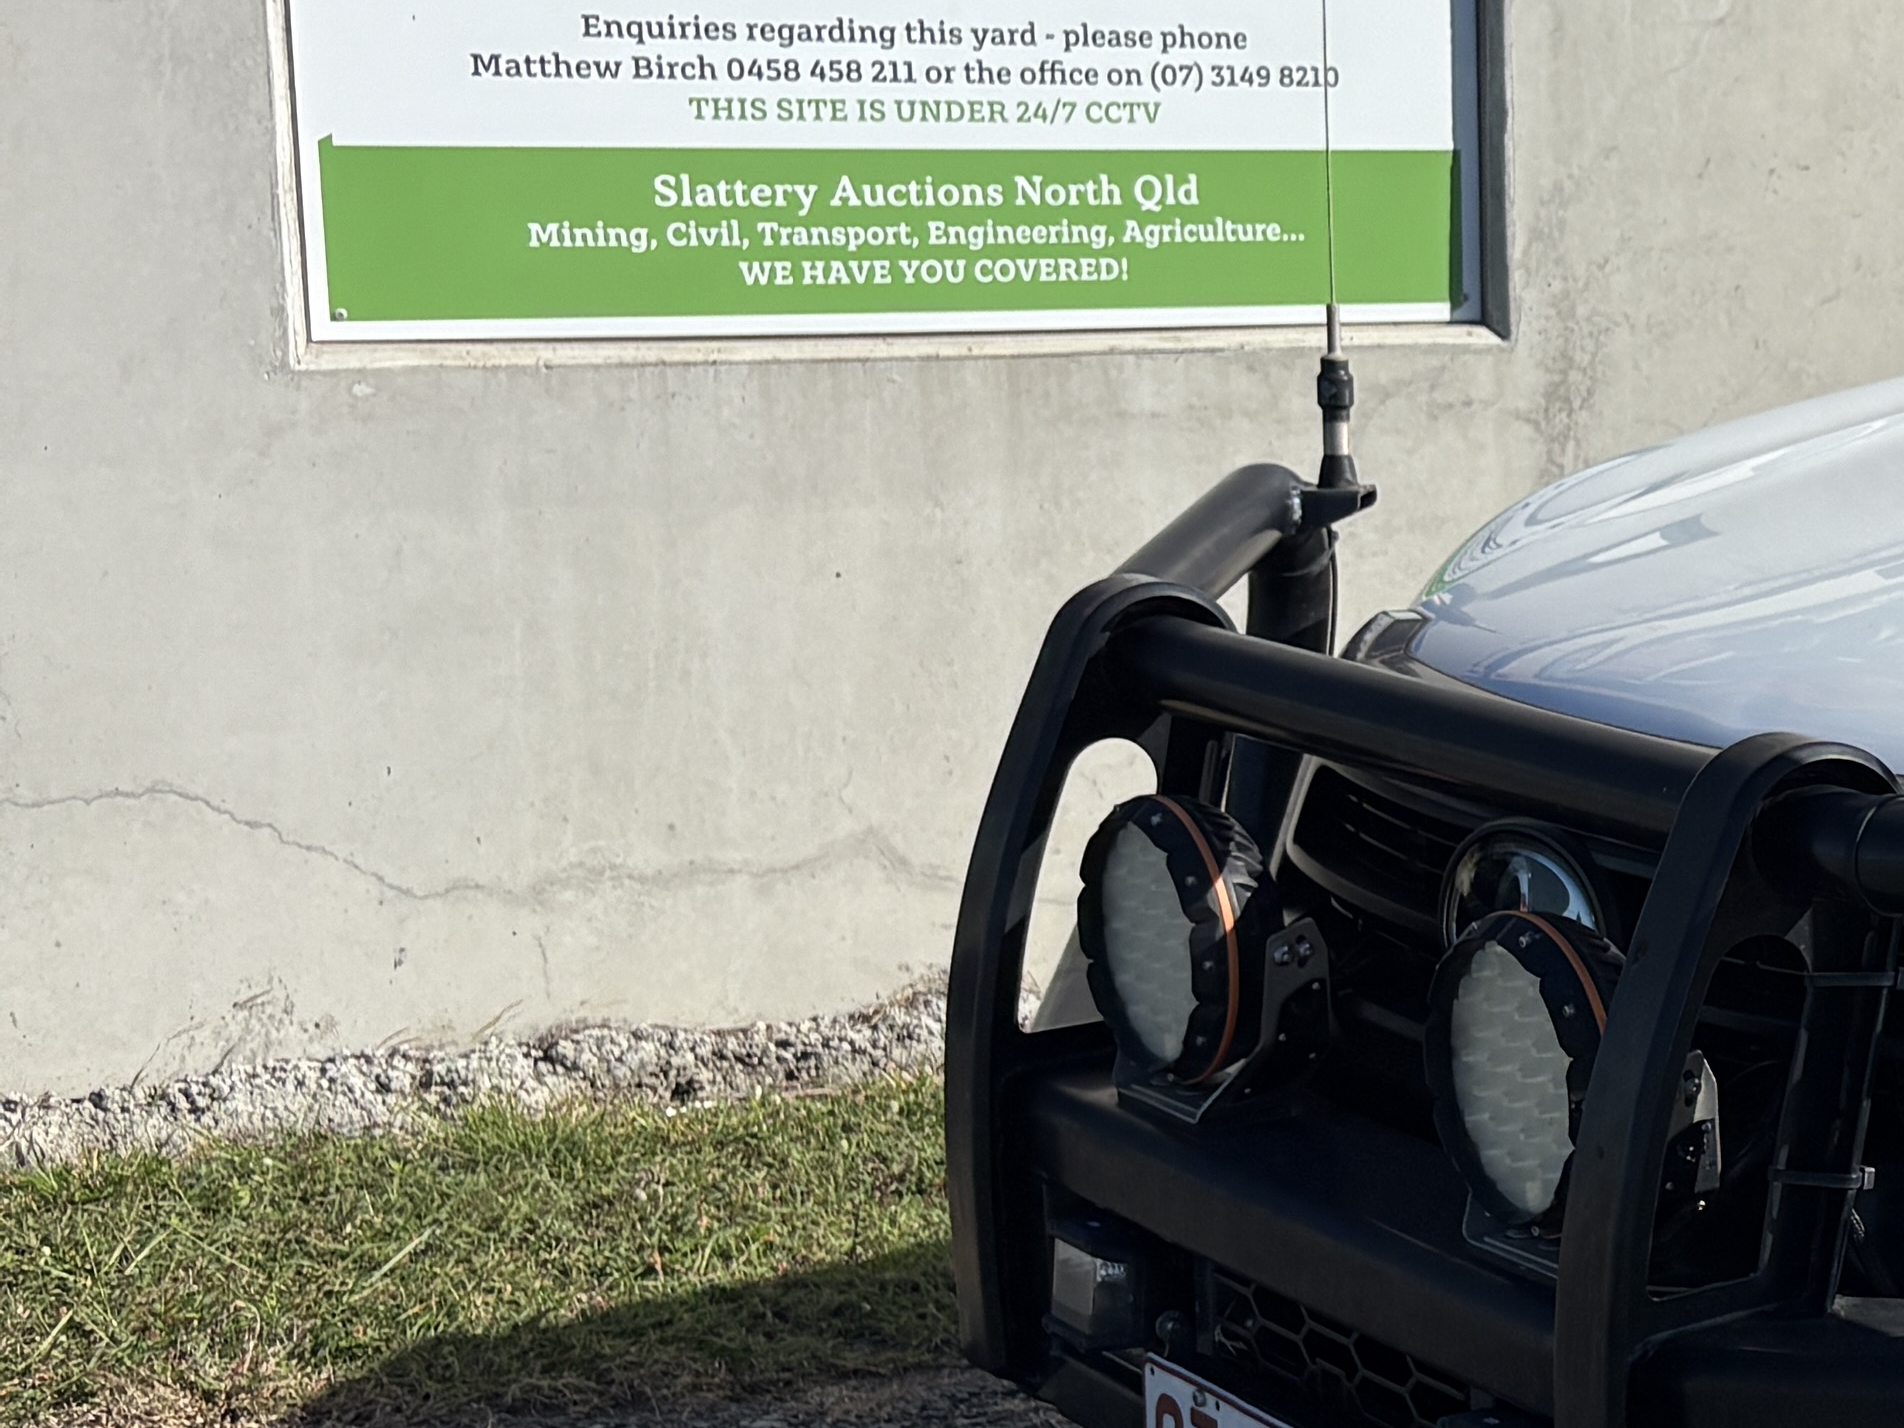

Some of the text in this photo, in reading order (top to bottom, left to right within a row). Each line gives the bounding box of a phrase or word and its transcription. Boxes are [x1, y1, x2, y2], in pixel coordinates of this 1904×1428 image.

[582, 15, 736, 44] Enquiries
[747, 18, 895, 49] regarding
[906, 19, 962, 44] this
[971, 22, 1035, 51] yard
[1064, 23, 1152, 52] please
[1161, 25, 1246, 53] phone
[471, 52, 1341, 91] Matthew Birch 0458 458 211 or the office on (07) 3149 8210
[689, 98, 1159, 123] THIS SITE IS UNDER 24/7 CCTV
[654, 174, 1199, 212] Slattery Auctions North Qld
[528, 221, 657, 253] Mining,
[667, 219, 749, 250] Civil,
[757, 222, 919, 251] Transport,
[928, 219, 1114, 250] Engineering,
[739, 258, 1128, 285] WE HAVE YOU COVERED!
